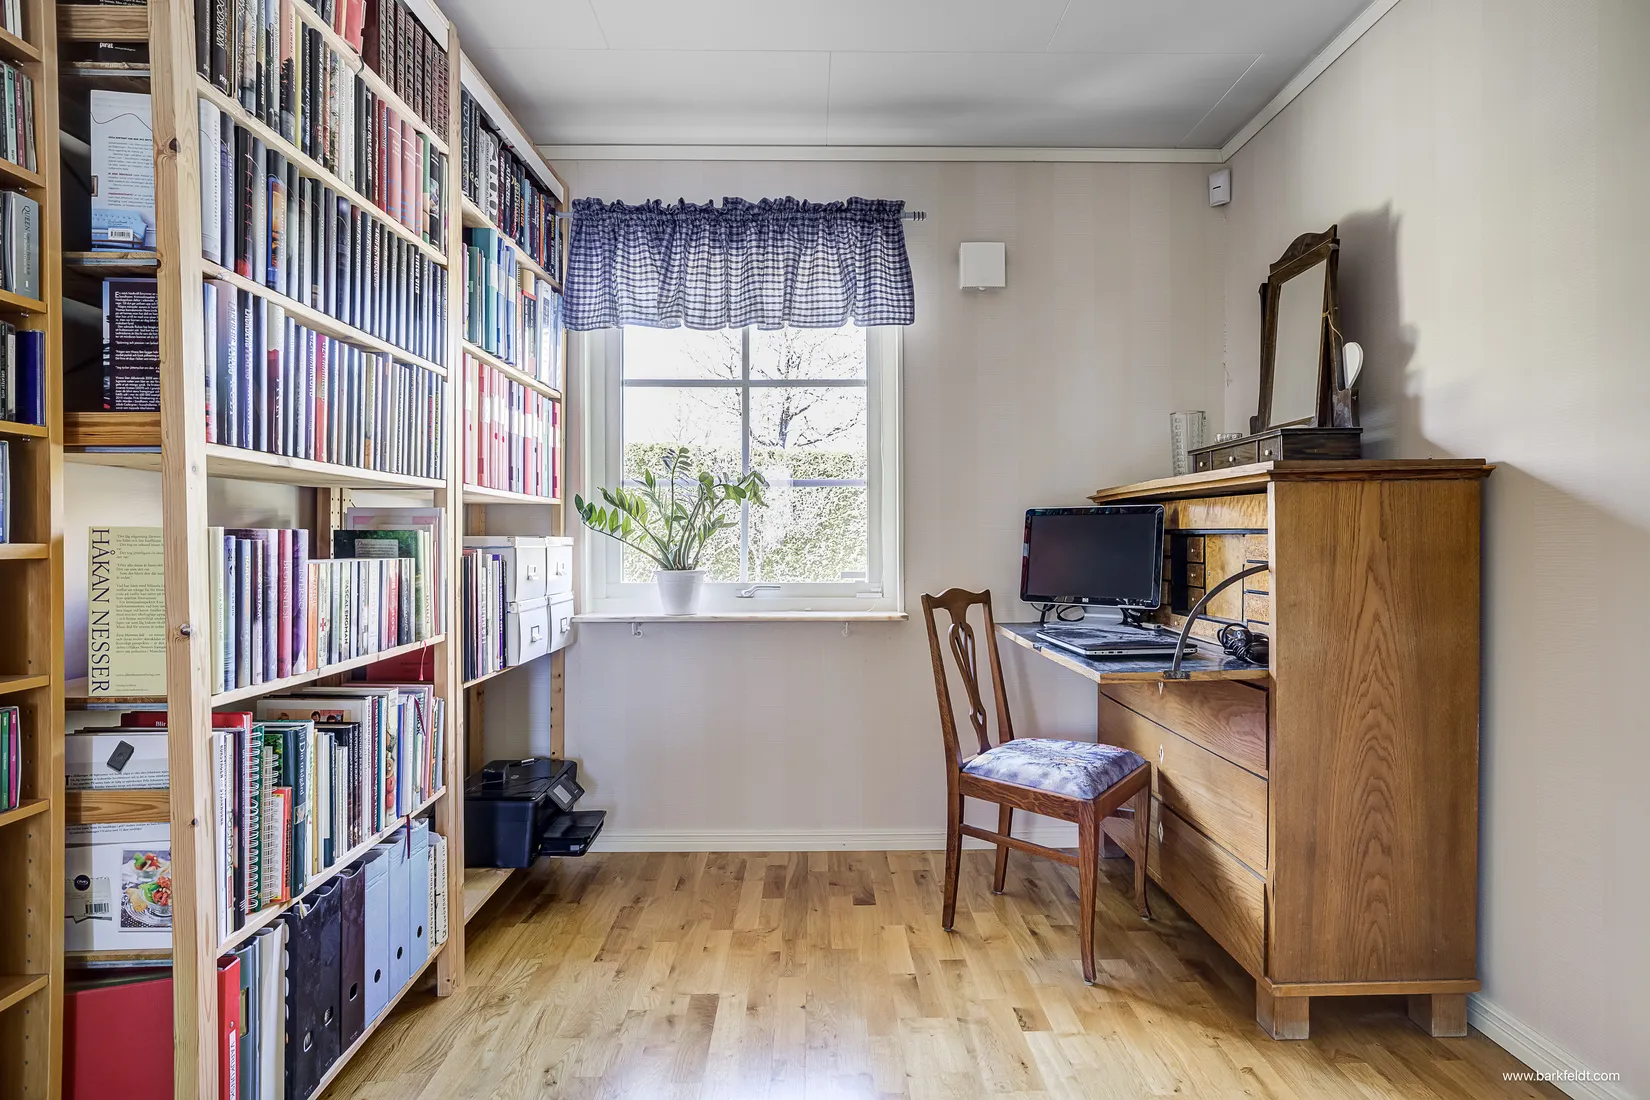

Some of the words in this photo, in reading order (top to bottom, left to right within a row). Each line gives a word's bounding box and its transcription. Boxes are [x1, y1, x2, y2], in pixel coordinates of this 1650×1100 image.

[22, 205, 31, 232] QUEEN
[92, 529, 115, 602] HÅKAN
[92, 610, 110, 693] NESSER
